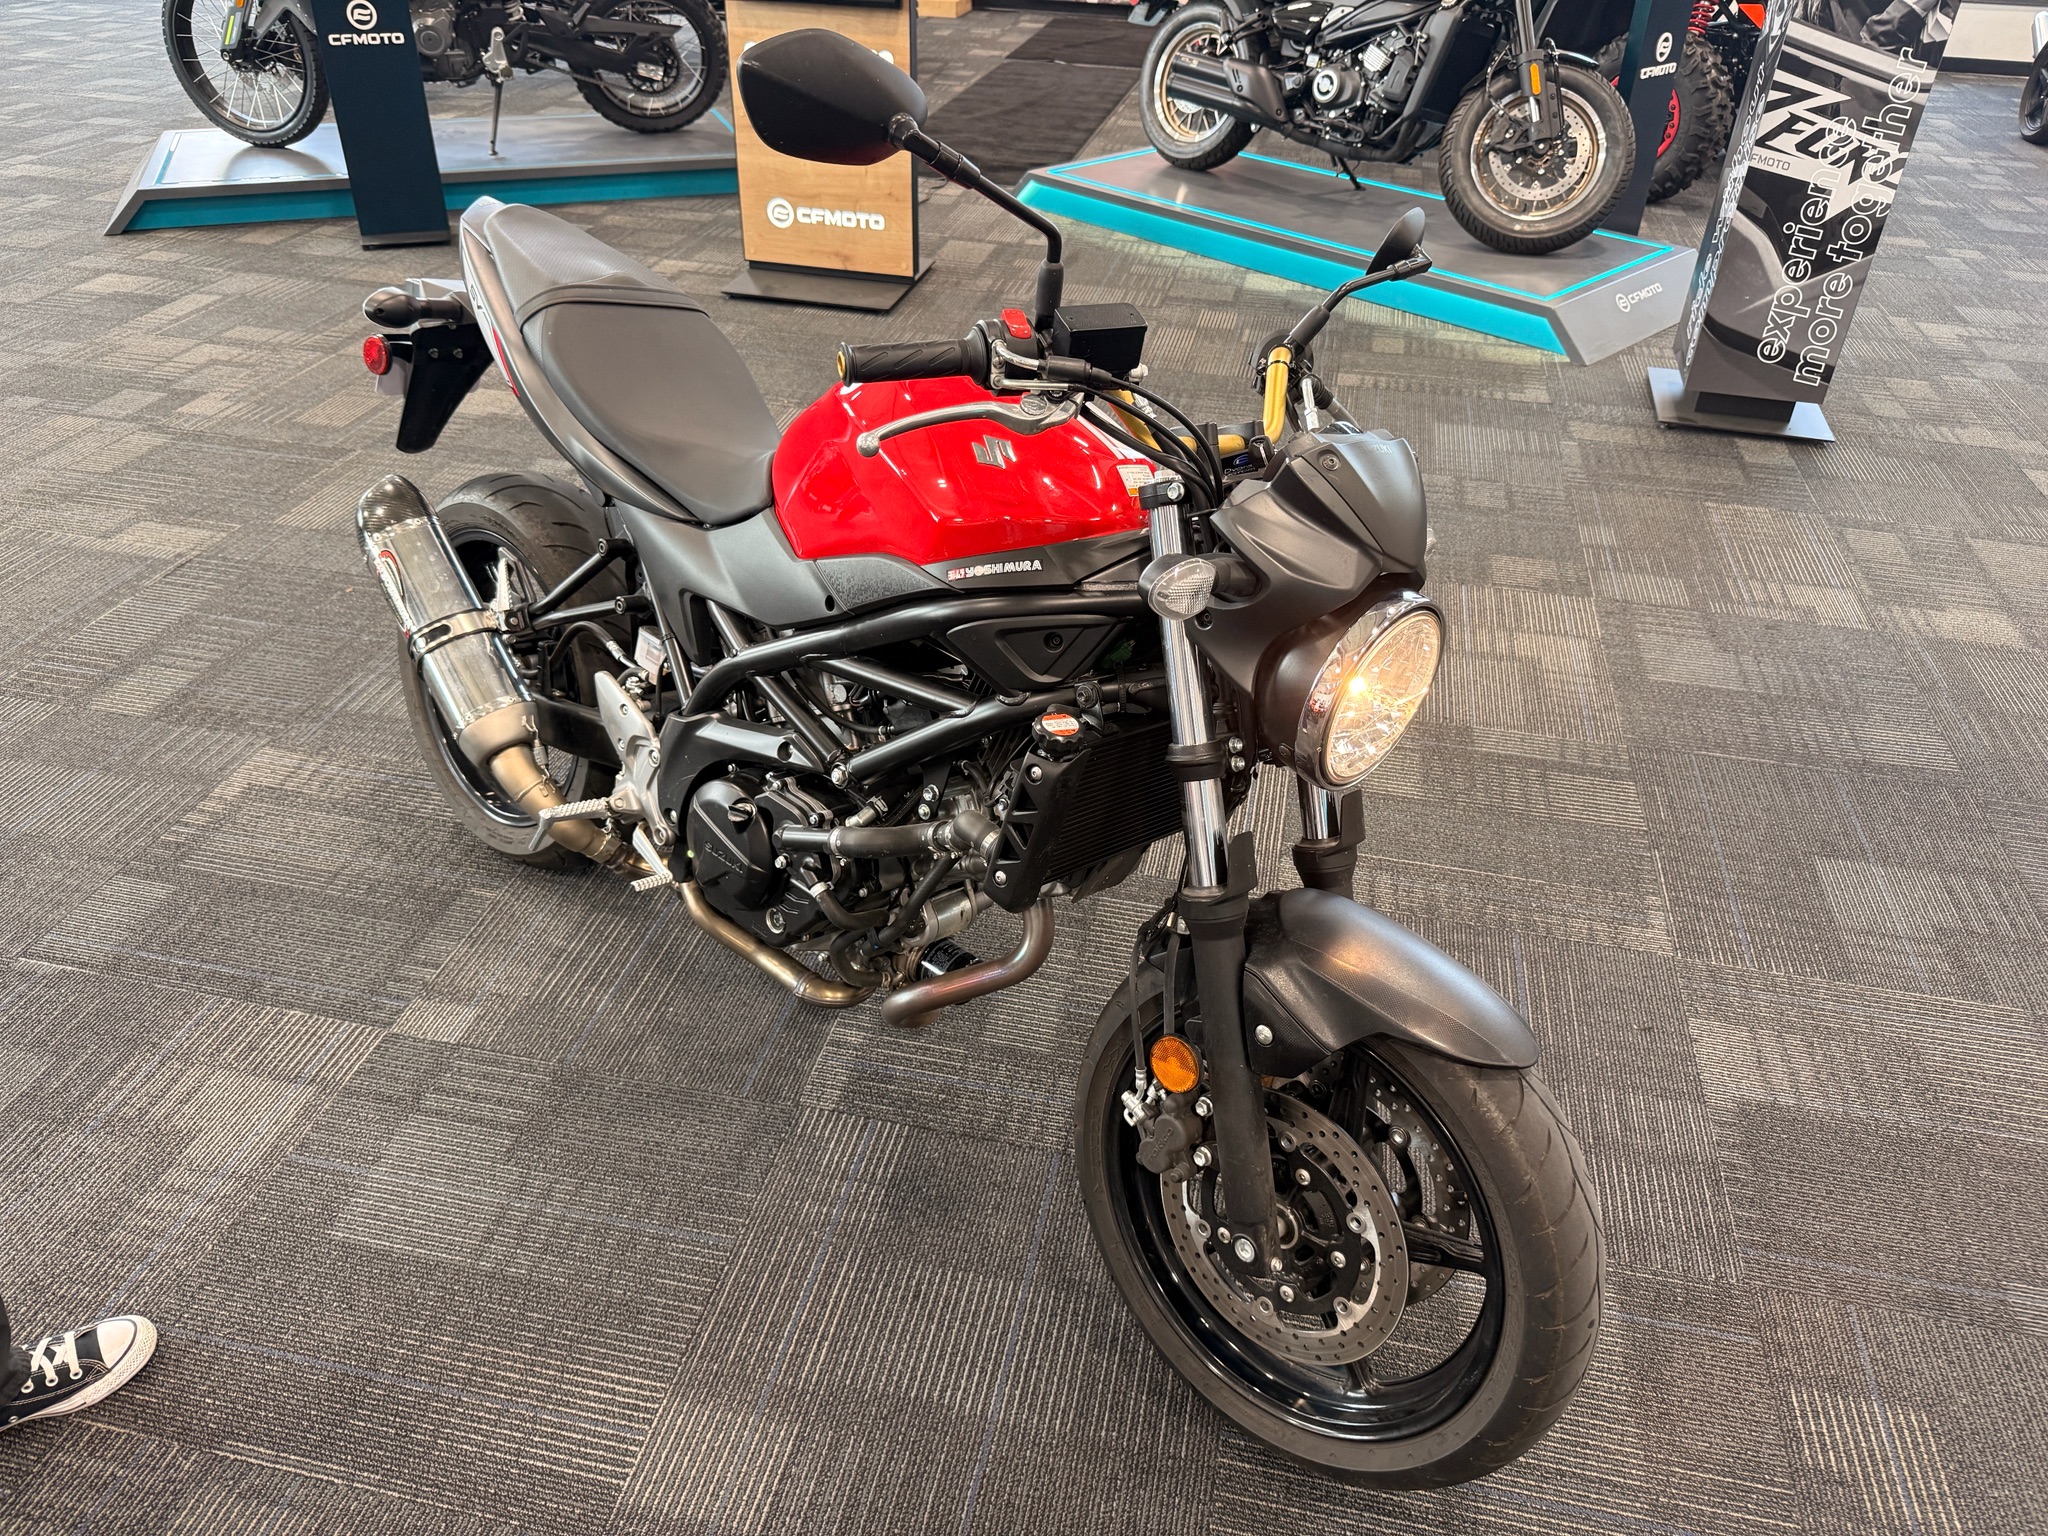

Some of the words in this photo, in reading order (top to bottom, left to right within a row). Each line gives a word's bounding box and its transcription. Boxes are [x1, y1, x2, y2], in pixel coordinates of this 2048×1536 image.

[328, 33, 405, 46] CFMOTO
[1640, 62, 1677, 80] CFMOTO
[1750, 153, 1791, 171] FMOTO
[796, 206, 886, 231] CFMOTO
[1793, 272, 1853, 386] more
[1826, 46, 1928, 262] together
[1757, 117, 1857, 363] experience
[1627, 282, 1663, 304] CFMOTO
[965, 560, 1043, 578] YOSHIMURA
